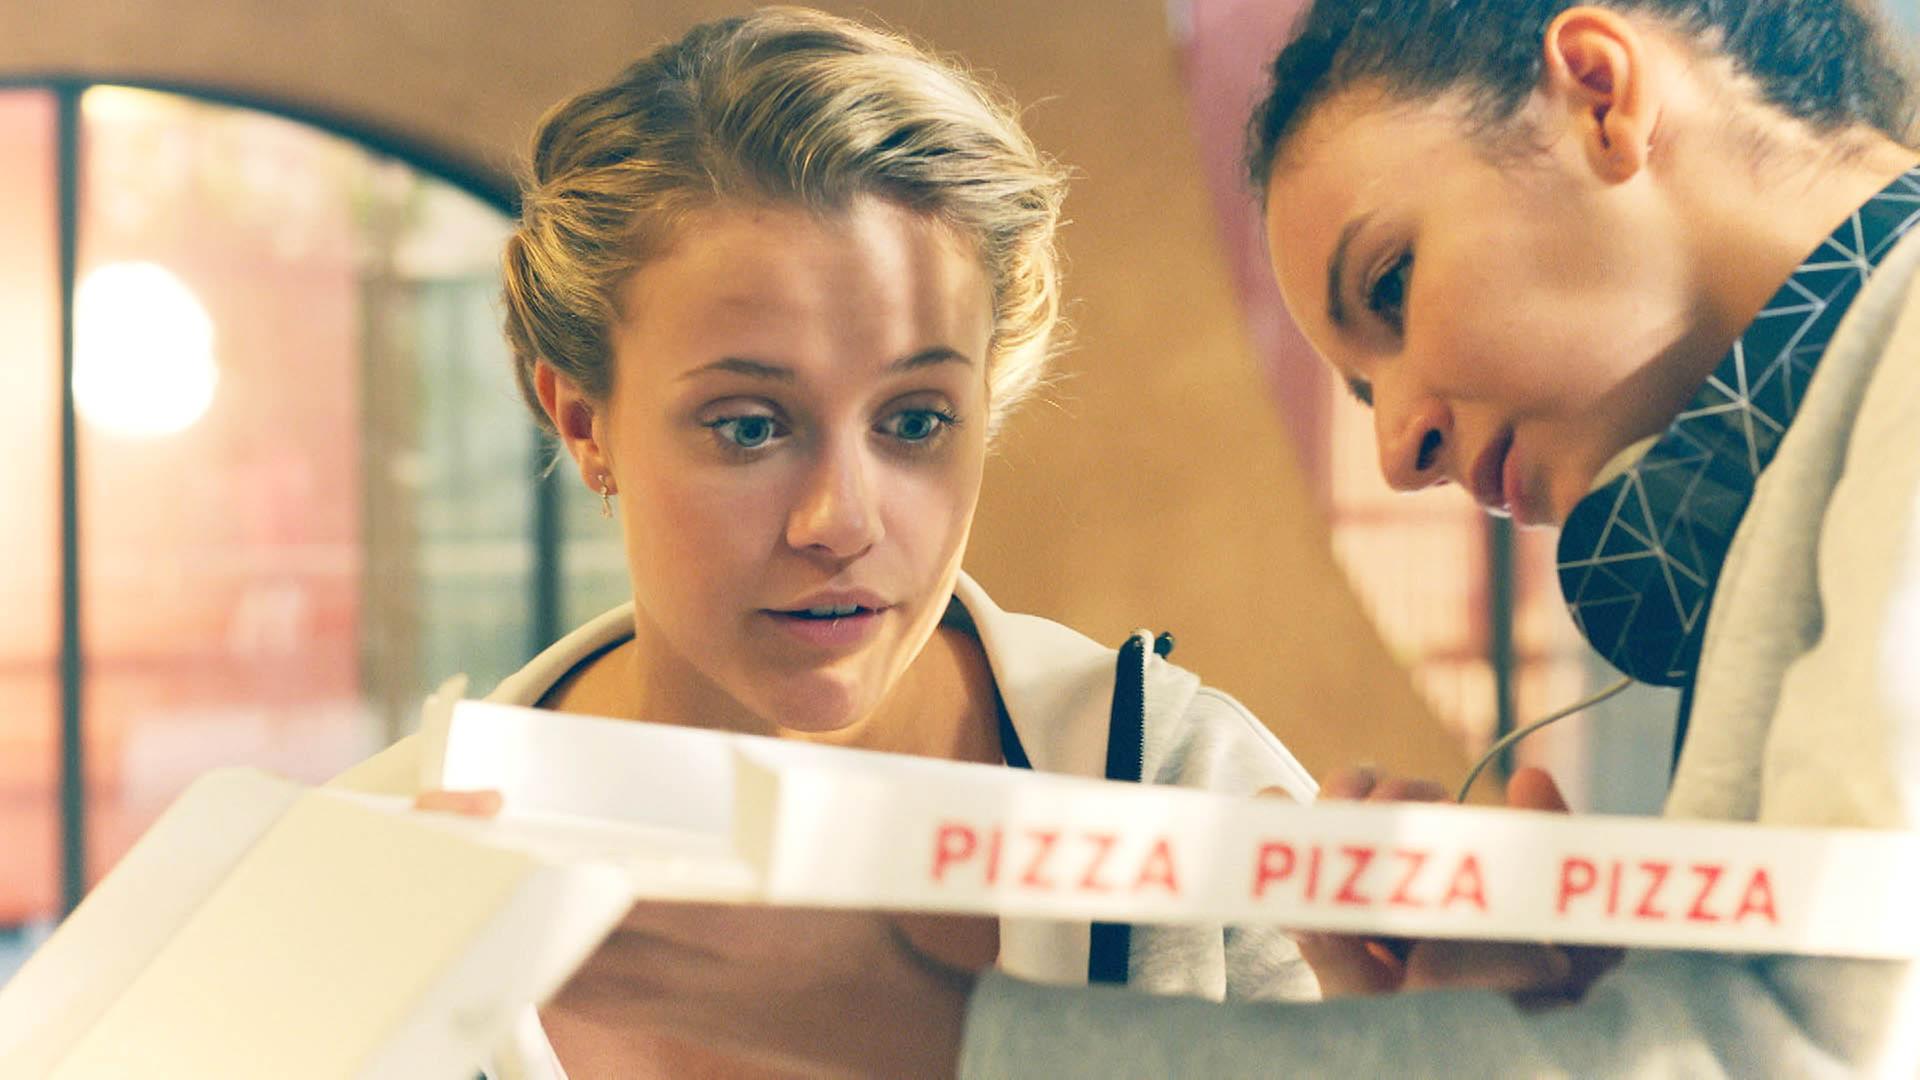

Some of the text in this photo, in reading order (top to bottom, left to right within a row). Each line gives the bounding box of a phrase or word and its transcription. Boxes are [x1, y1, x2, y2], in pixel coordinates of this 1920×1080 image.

[931, 823, 1778, 924] PIZZA PIZZA PIZZA
